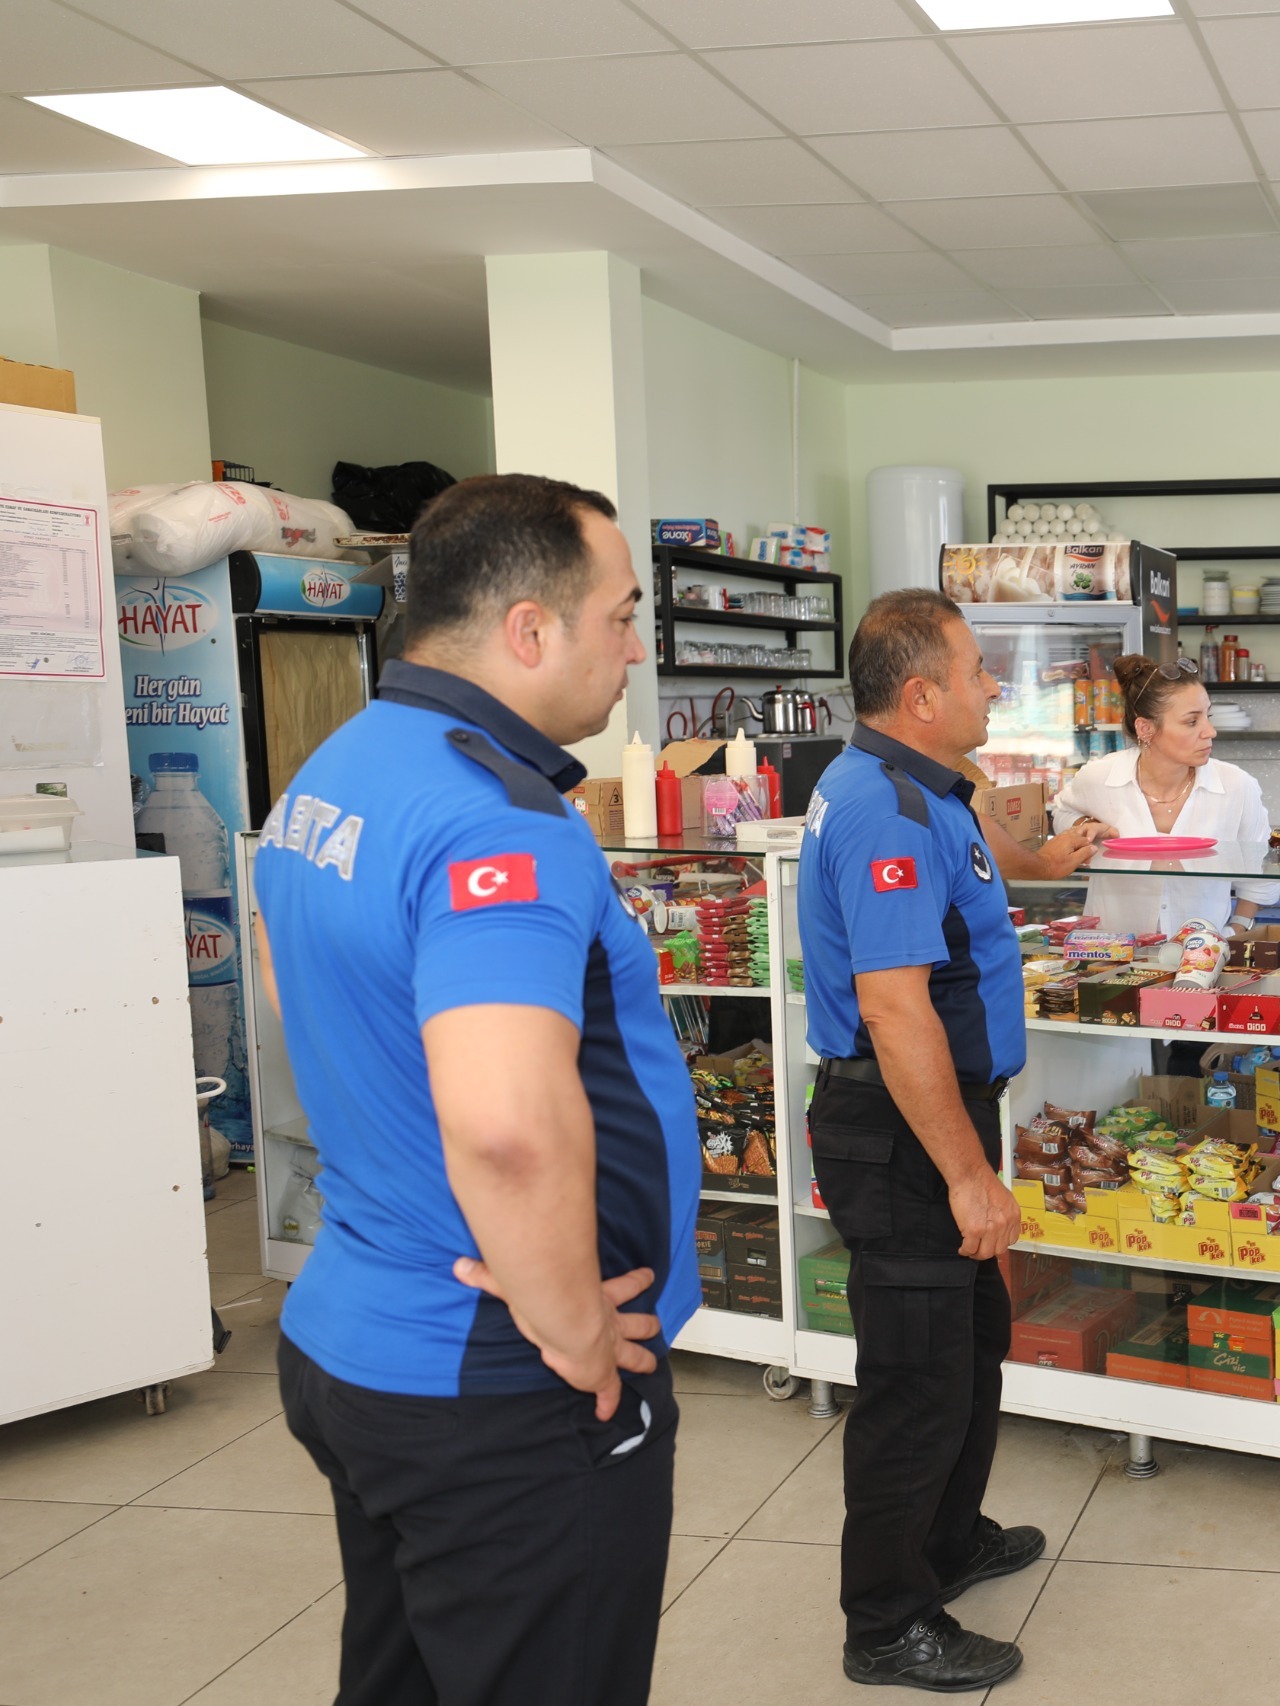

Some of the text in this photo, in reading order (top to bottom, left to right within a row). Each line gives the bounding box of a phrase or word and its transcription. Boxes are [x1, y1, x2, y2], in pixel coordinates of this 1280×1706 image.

[1065, 544, 1103, 554] Balkan
[307, 580, 344, 600] HAYAT
[118, 603, 202, 634] HAYAT
[135, 675, 202, 701] Her gün
[125, 703, 229, 729] eni bir Hayat
[186, 934, 221, 958] YAT
[1068, 951, 1112, 959] mentos
[1213, 1352, 1240, 1370] Çizi
